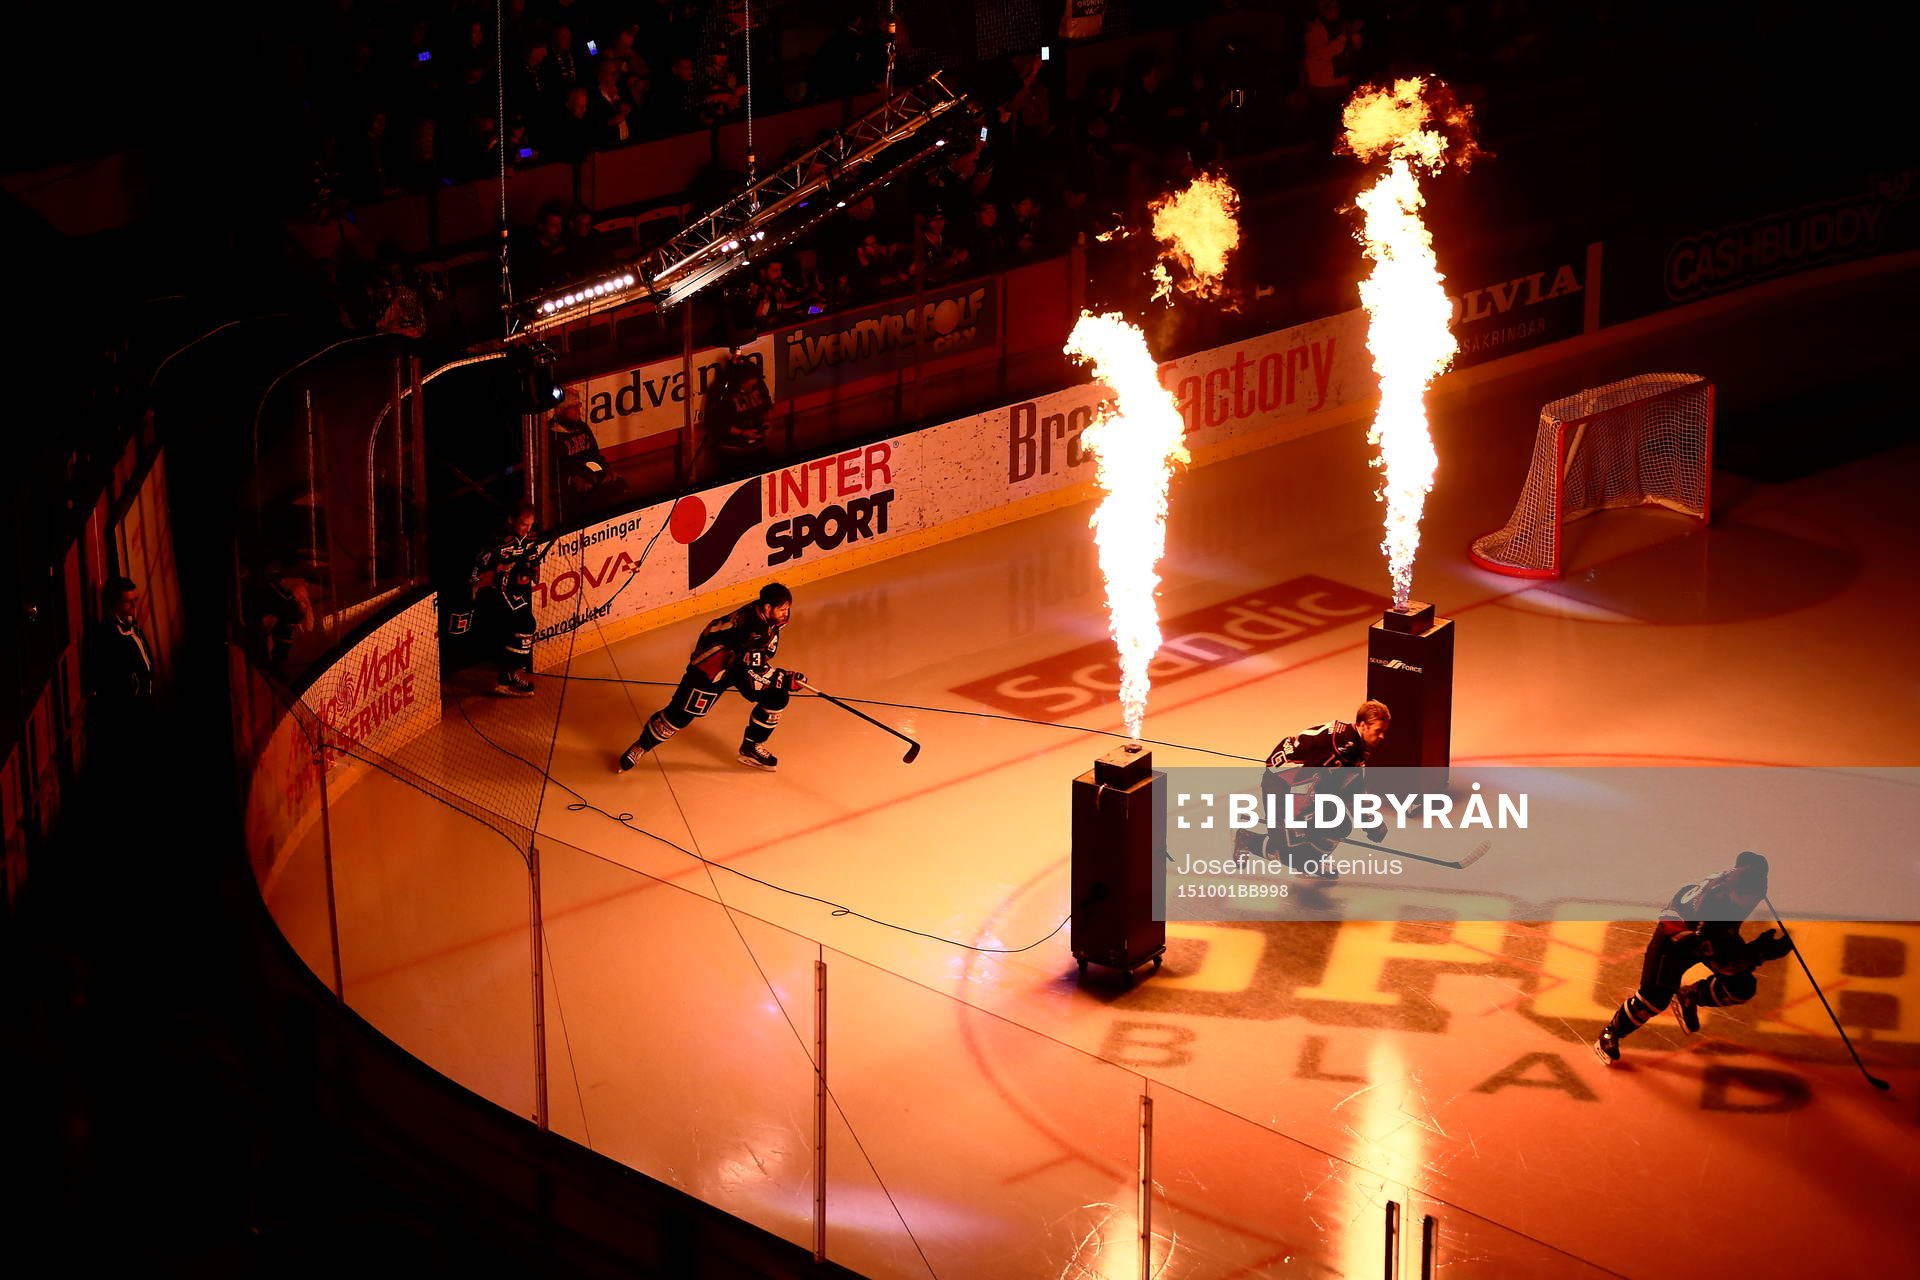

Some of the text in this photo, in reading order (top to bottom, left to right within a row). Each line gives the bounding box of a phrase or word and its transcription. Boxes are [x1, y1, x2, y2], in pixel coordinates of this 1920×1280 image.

[1670, 202, 1885, 289] CASHBUDDY
[767, 442, 892, 517] INTER
[557, 517, 642, 557] Inglasningar
[765, 488, 895, 567] SPORT
